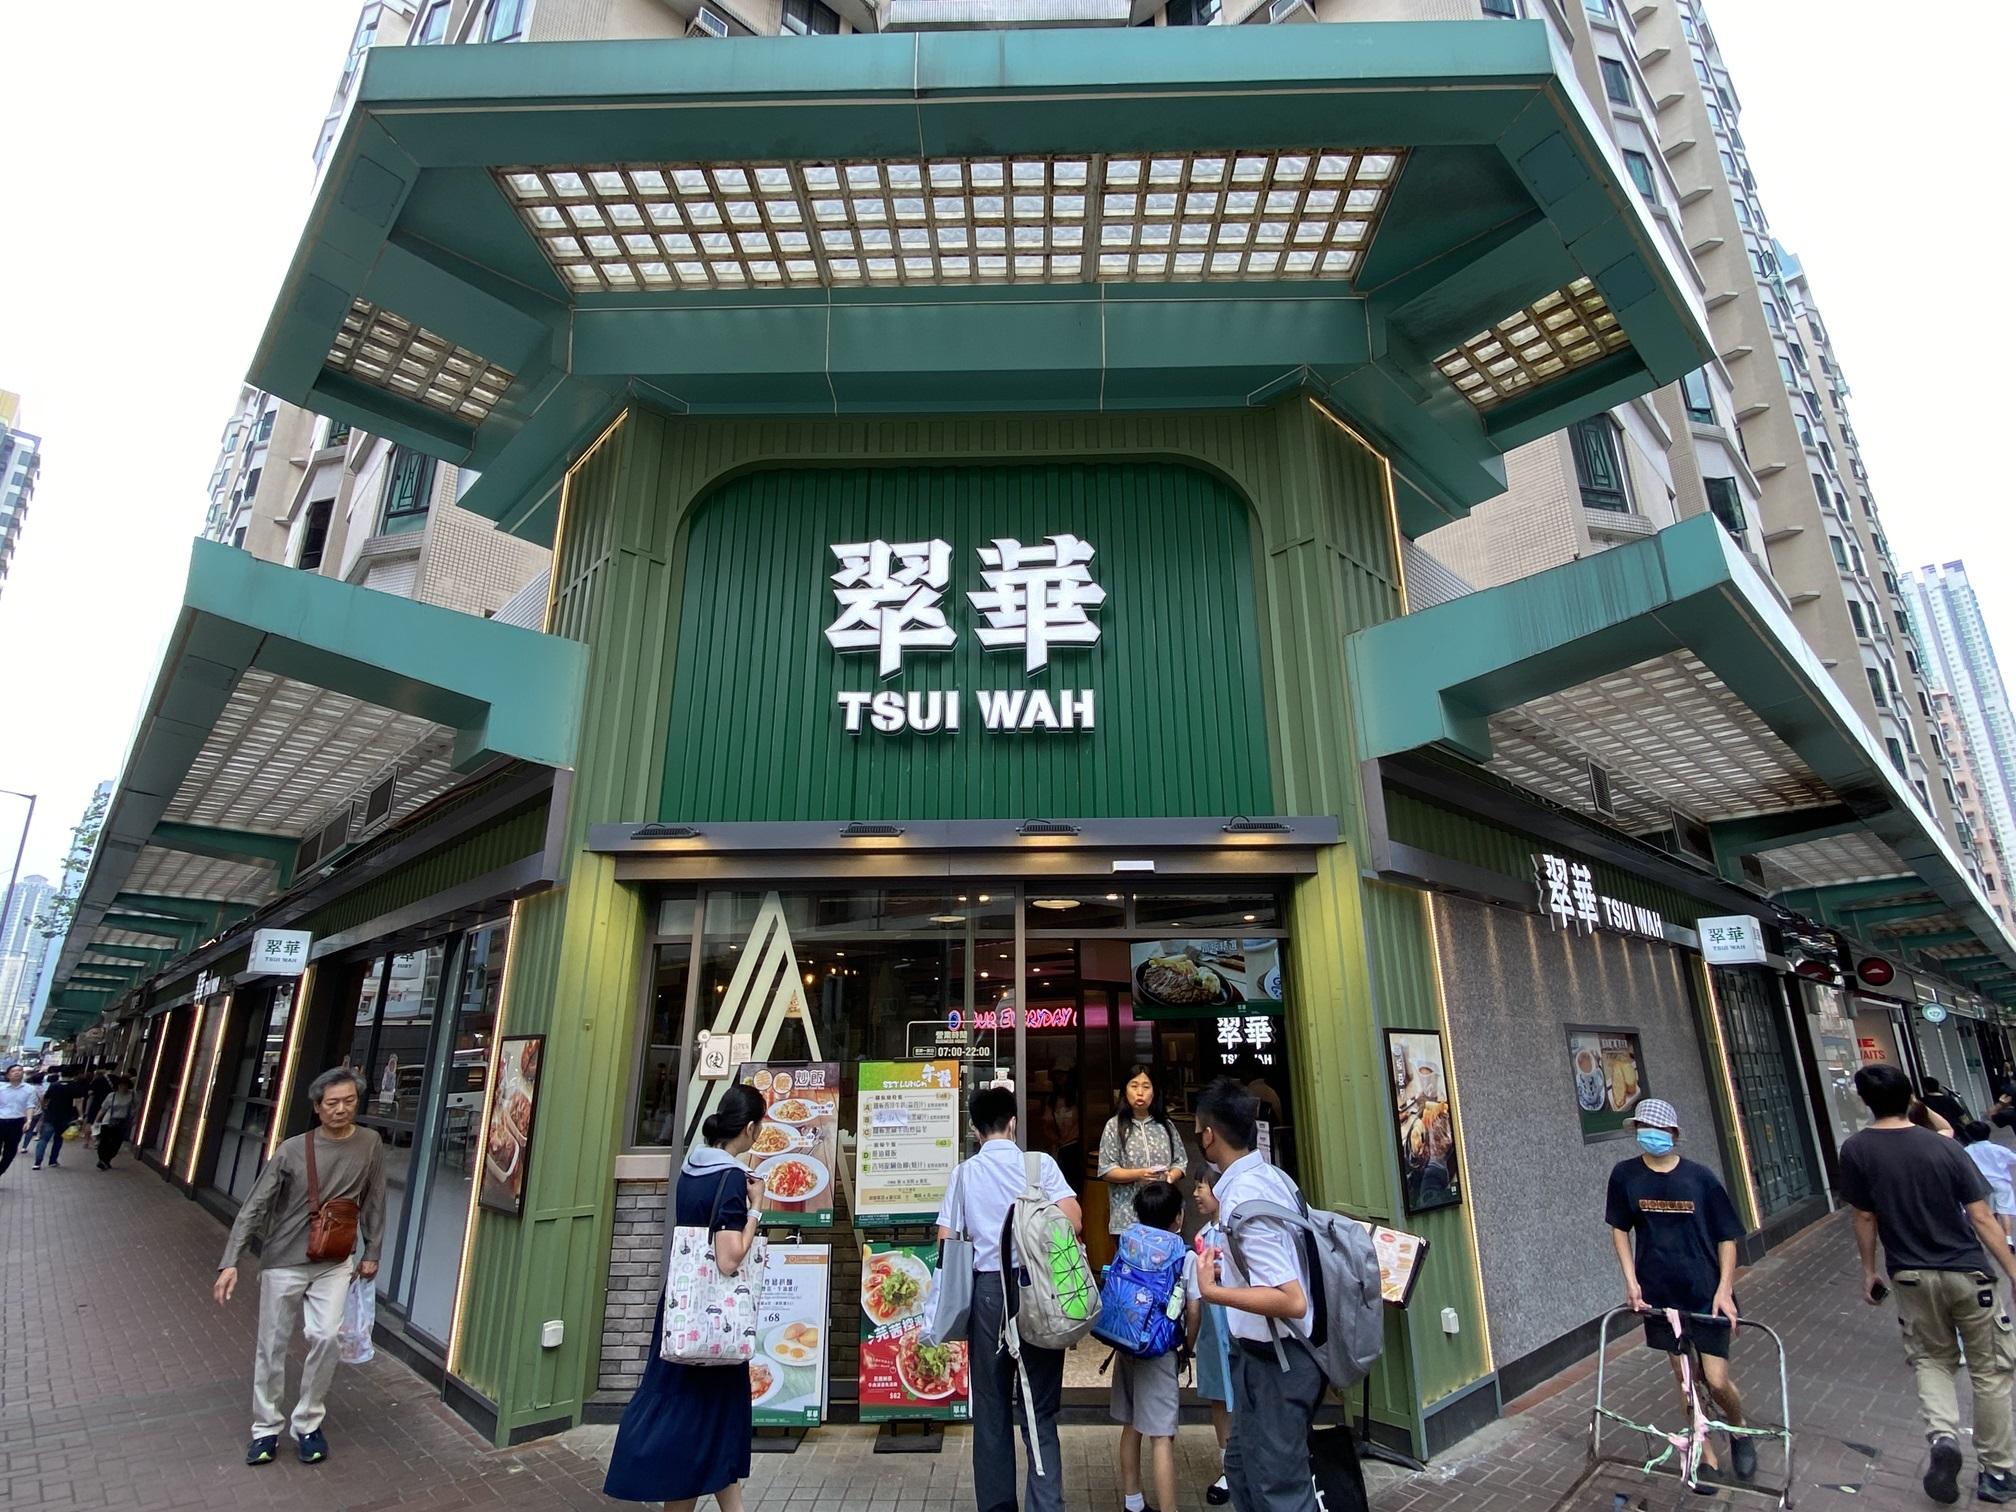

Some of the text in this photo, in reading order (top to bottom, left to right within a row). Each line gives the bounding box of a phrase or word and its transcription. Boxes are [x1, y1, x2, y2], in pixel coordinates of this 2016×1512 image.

[824, 533, 1107, 681] 翠華
[837, 688, 1095, 734] TSUI WAH
[1543, 854, 1599, 934] 翠華
[1601, 895, 1664, 939] TSUI WAH
[265, 939, 301, 956] 翠華
[1708, 926, 1744, 944] 翠華
[1217, 1016, 1272, 1050] 翠華
[937, 1046, 990, 1057] 07:00-22:00
[1860, 1050, 1886, 1061] AITS
[794, 1069, 826, 1086] 炒飯
